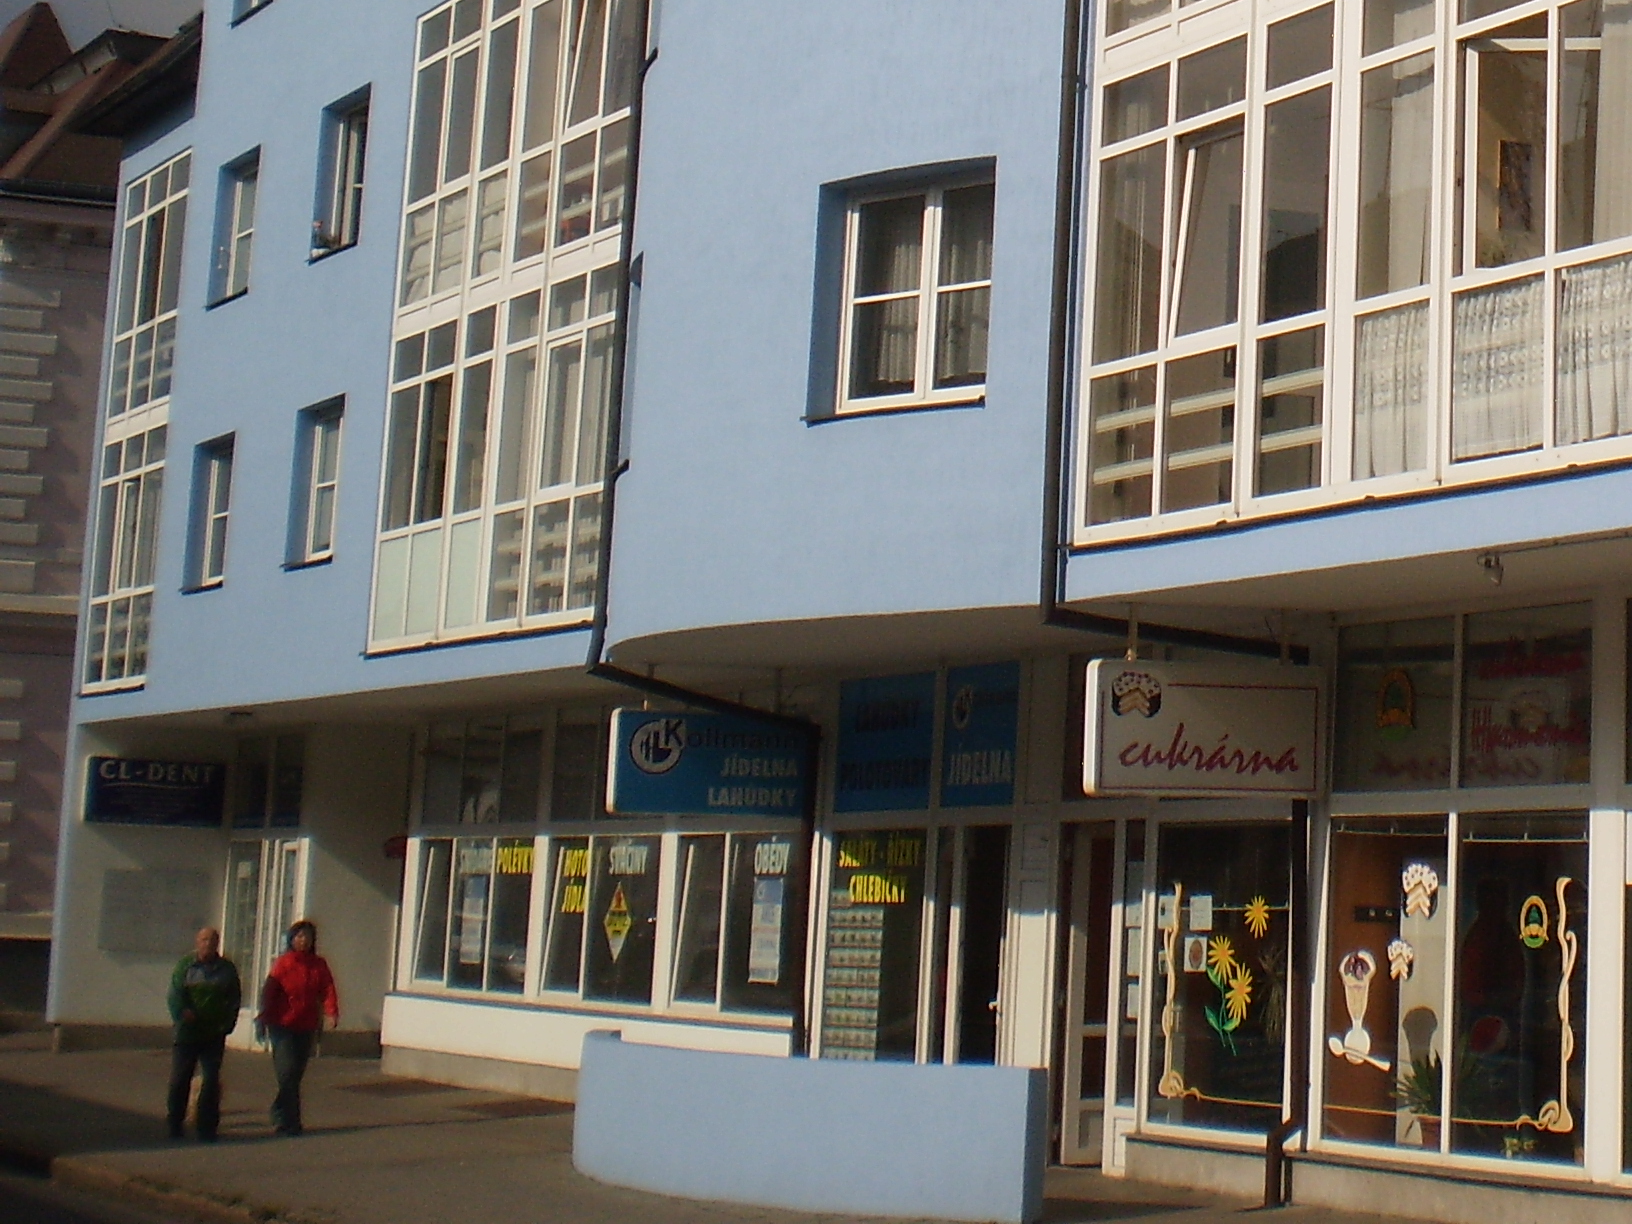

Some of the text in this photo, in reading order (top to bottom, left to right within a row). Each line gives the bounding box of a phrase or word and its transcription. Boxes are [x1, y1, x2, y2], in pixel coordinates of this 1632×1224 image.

[1119, 722, 1300, 775] cukrárna
[98, 759, 216, 783] CL-DENT
[720, 753, 798, 777] JÍDELNA
